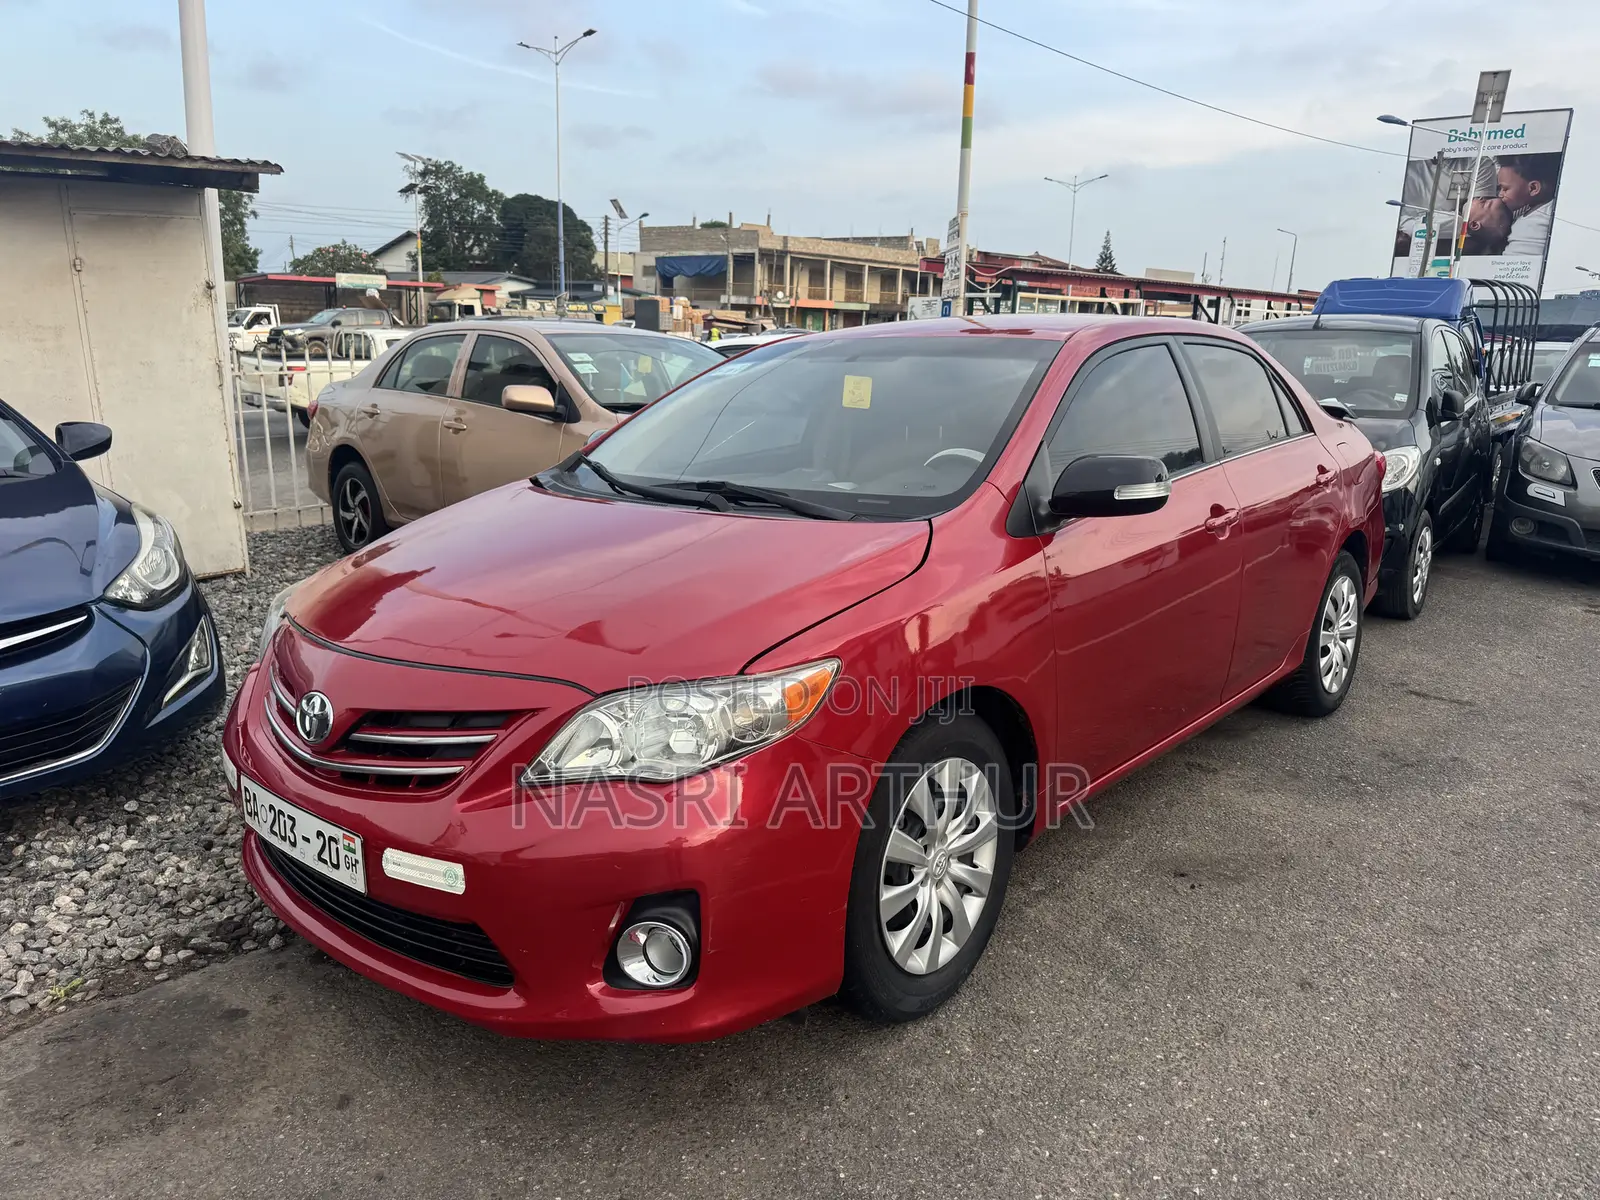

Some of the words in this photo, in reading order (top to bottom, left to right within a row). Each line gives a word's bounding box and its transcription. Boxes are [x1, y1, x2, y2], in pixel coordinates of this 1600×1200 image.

[1441, 146, 1461, 154] Baby's
[1502, 142, 1528, 150] product
[1510, 265, 1531, 274] gentle
[244, 785, 260, 828] BA
[344, 854, 359, 875] GH
